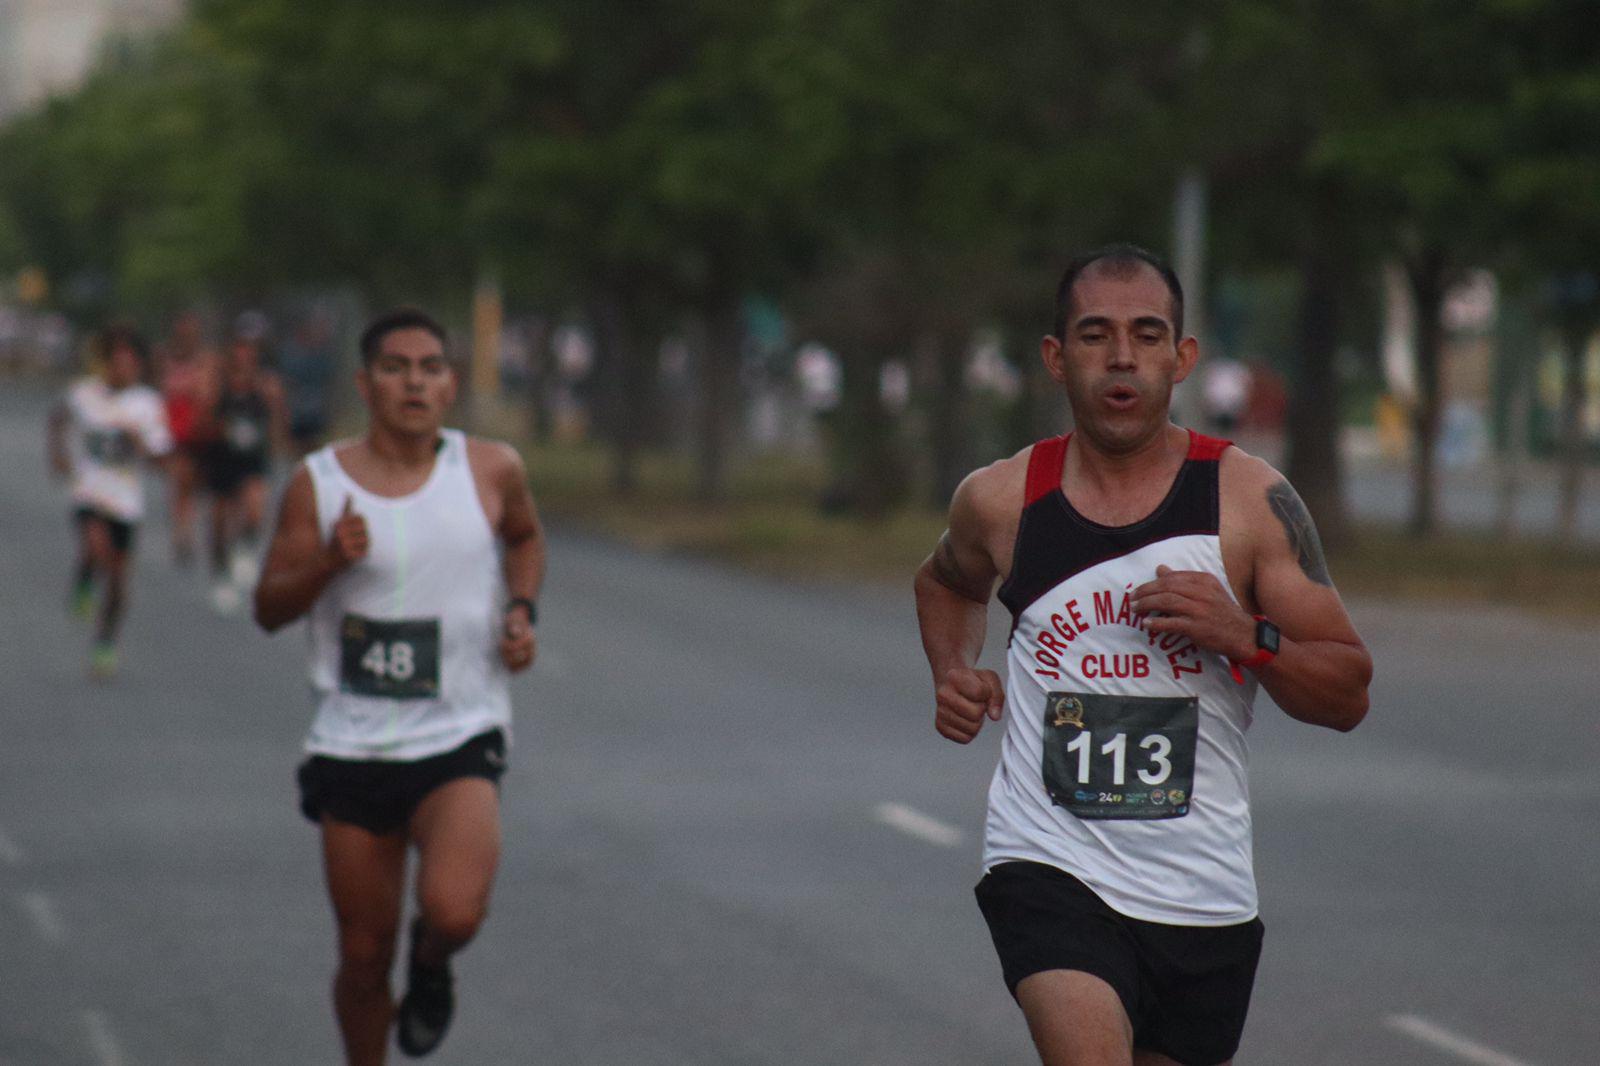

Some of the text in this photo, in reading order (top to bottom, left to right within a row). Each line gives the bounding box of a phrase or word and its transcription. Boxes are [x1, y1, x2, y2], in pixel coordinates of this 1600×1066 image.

[361, 640, 415, 679] 48
[1035, 599, 1090, 680] JORGE
[1081, 653, 1150, 679] CLUB
[1067, 730, 1172, 786] 113
